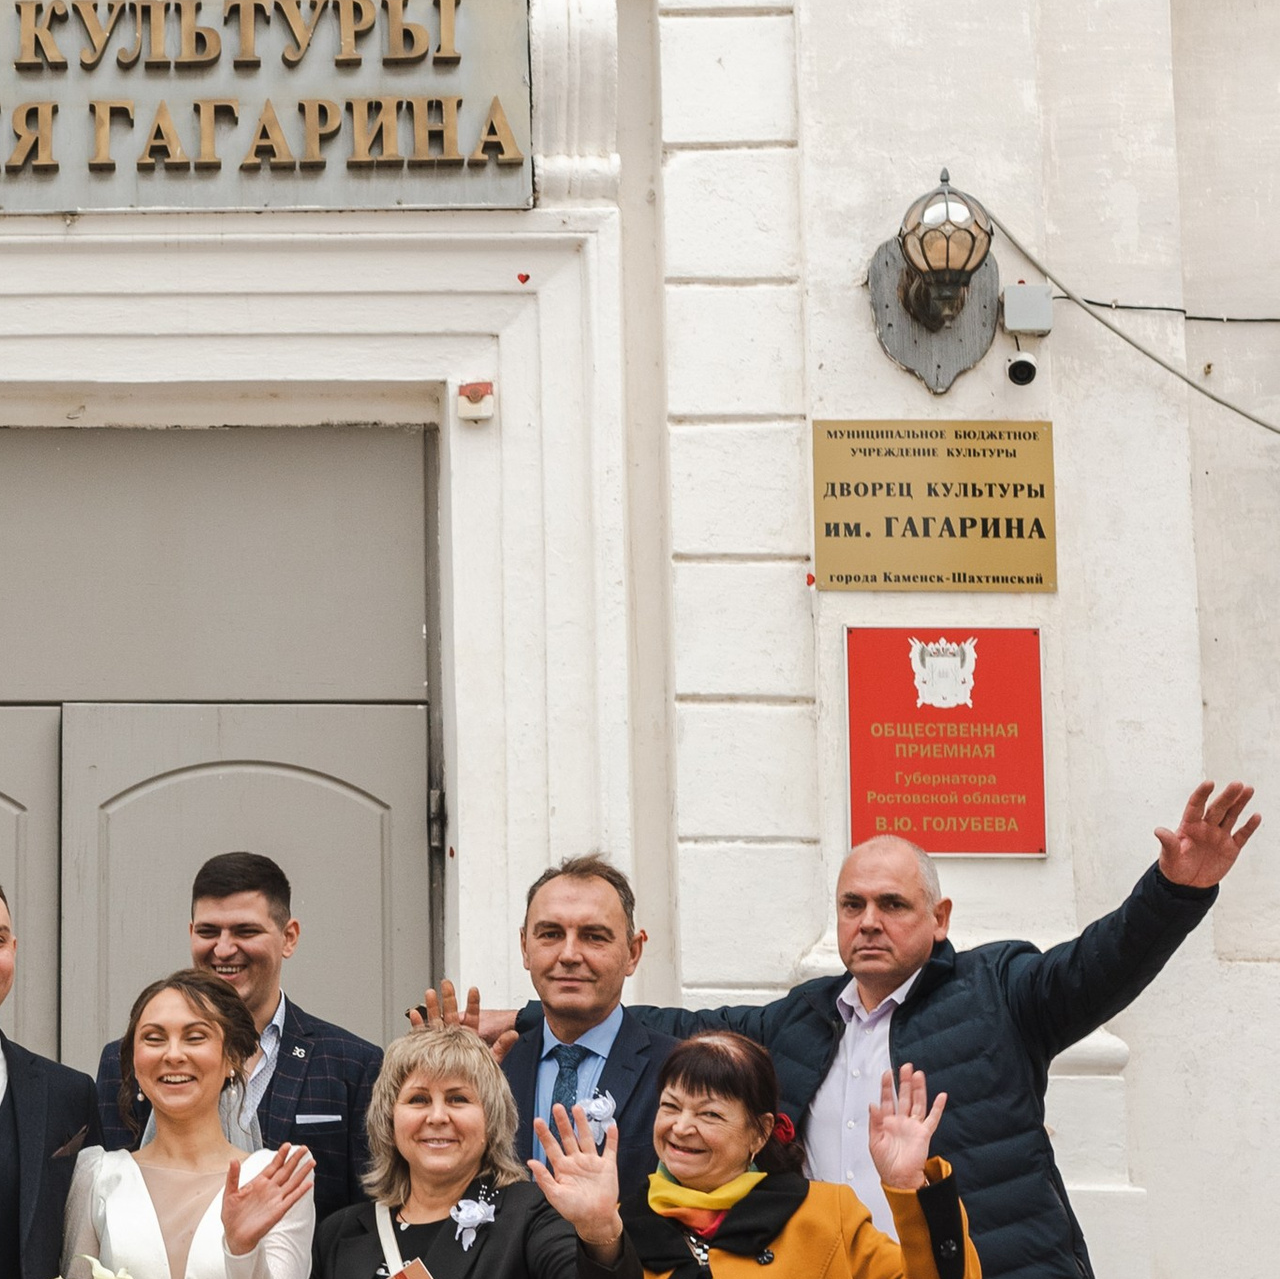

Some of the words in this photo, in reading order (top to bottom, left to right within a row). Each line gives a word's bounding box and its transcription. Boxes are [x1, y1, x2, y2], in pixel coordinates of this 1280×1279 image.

[88, 94, 523, 173] ГАГАРИНА
[826, 429, 947, 442] МУНИЦИПАЛЬНОЕ
[954, 429, 1040, 442] БЮДЖЕТНОЕ
[850, 447, 939, 458] УЧРЕЖДЕНИЕ
[946, 447, 1017, 459] КУЛЬТУРЫ
[823, 482, 914, 500] ДВОРЕЦ
[926, 482, 1045, 499] КУЛЬТУРЫ
[824, 522, 872, 538] им.
[884, 517, 1047, 539] ГАГАРИНА
[828, 573, 878, 585] города
[883, 572, 1044, 585] Каменск-Шахтинский
[870, 722, 1019, 738] ОБЩЕСТВЕННАЯ
[895, 743, 996, 758] ПРИЕМНАЯ
[894, 771, 997, 787] Губернатора
[866, 791, 958, 805] Ростовской
[962, 791, 1027, 805] области
[875, 817, 918, 832] В.Ю.
[922, 817, 1019, 832] ГОЛУБЕВА
